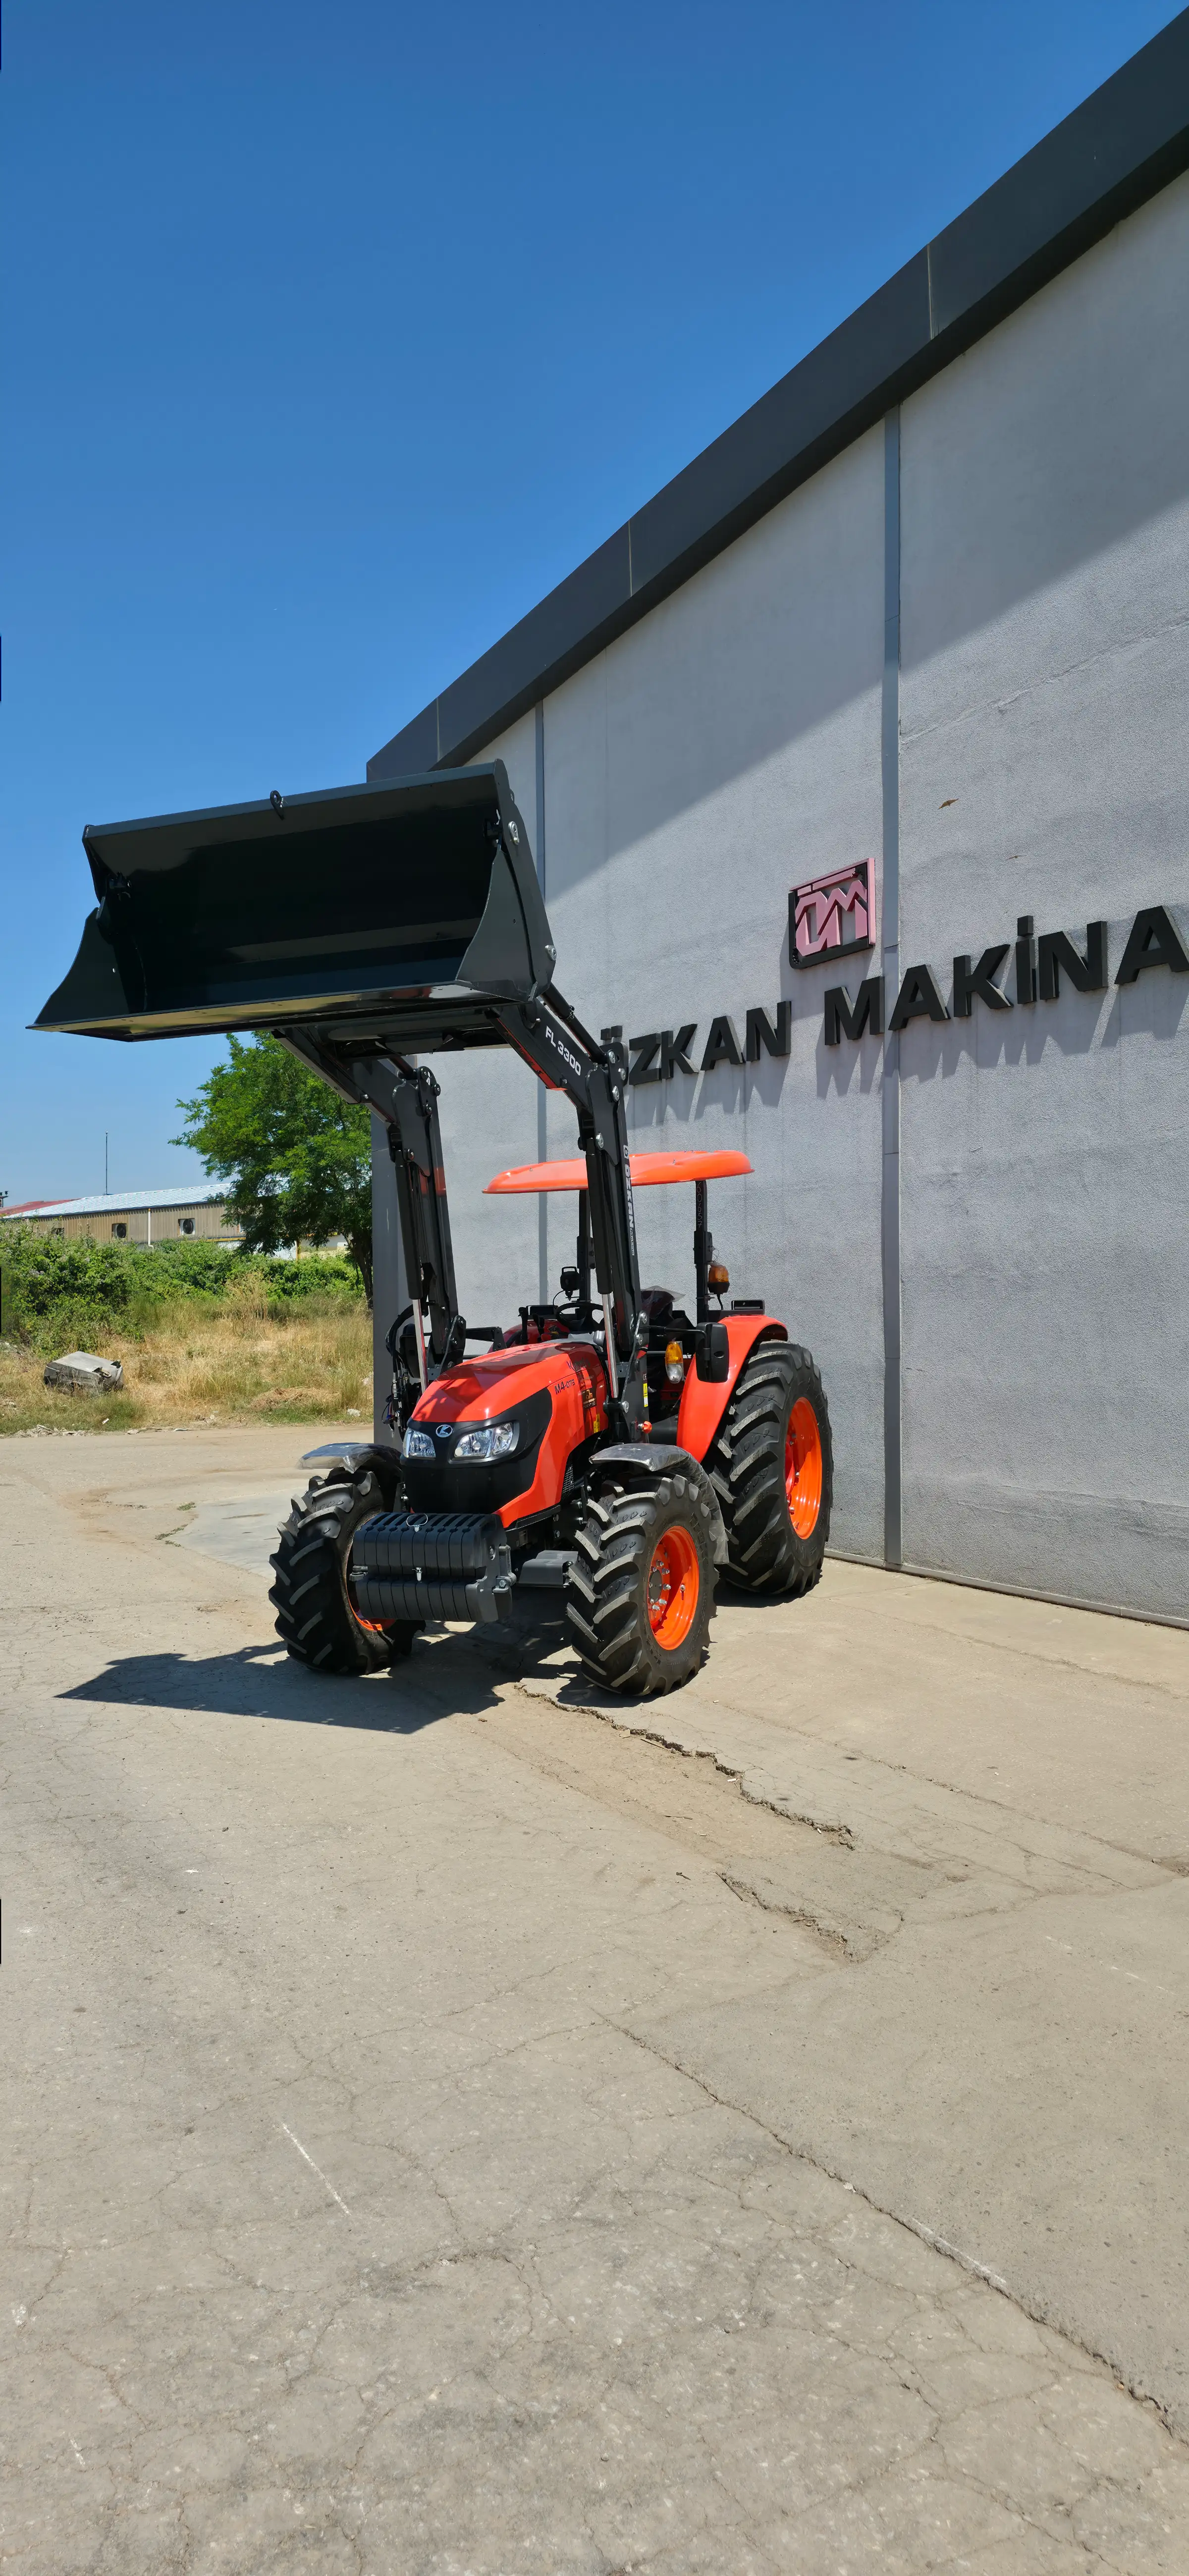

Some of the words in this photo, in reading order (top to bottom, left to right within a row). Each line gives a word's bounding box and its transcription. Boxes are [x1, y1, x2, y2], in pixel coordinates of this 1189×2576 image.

[545, 1025, 556, 1048] FL
[557, 1040, 581, 1076] 3300
[600, 1001, 792, 1086] ZKAN
[824, 905, 1189, 1046] MAKİNA
